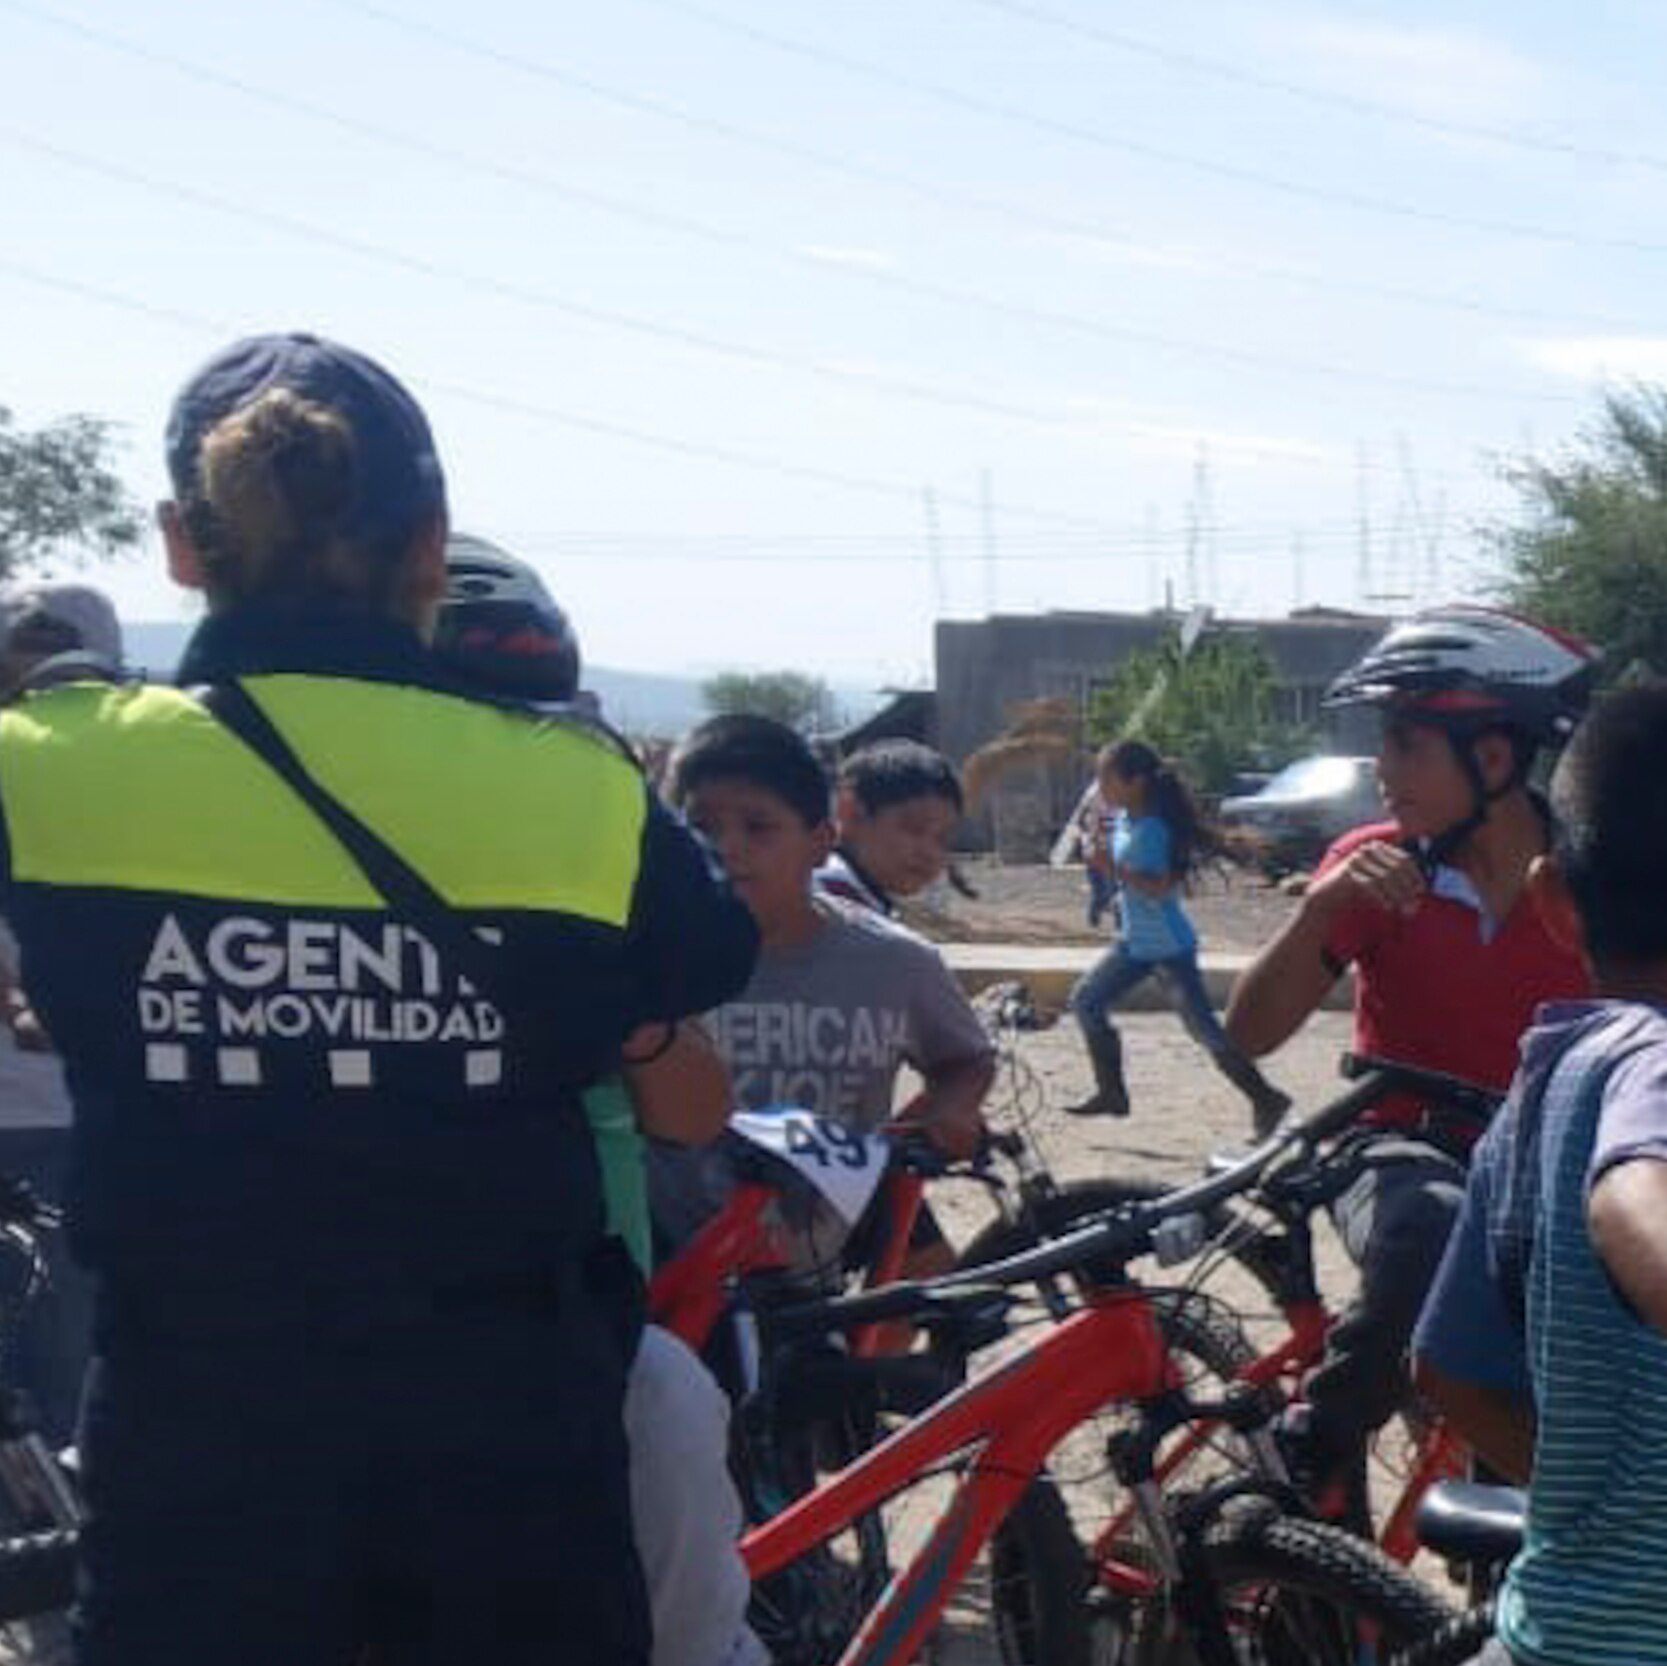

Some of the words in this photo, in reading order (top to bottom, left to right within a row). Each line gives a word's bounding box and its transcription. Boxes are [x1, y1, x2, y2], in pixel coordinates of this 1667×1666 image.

[140, 911, 505, 996] AGENT
[137, 986, 206, 1036] DE
[215, 992, 505, 1044] MOVILIDAD
[783, 1118, 869, 1168] 49
